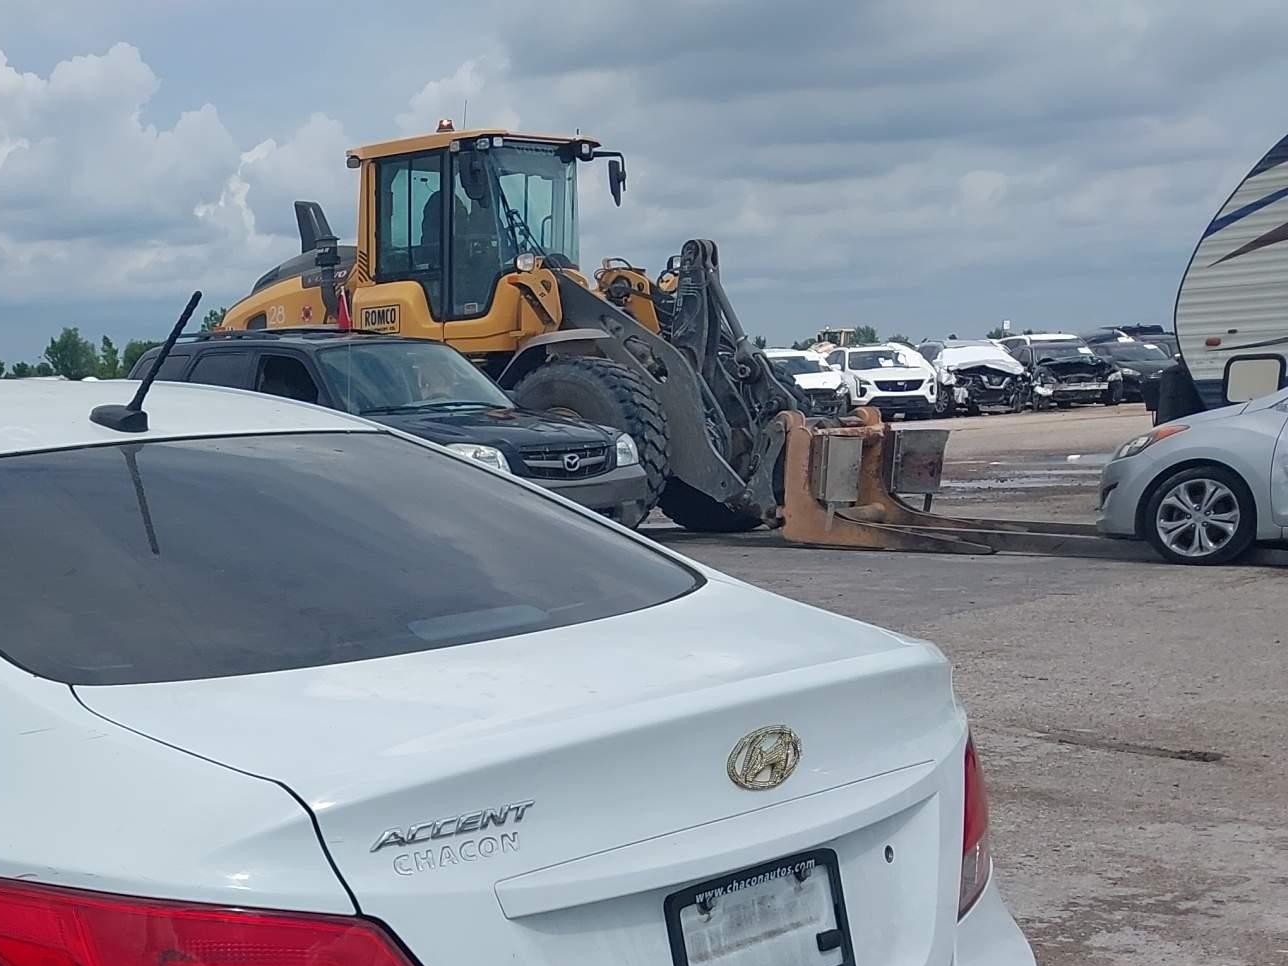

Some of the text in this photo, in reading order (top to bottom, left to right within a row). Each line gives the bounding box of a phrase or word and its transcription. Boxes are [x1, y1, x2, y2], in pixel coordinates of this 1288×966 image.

[364, 308, 396, 328] ROMCO
[370, 799, 536, 853] ACCENT
[393, 831, 521, 876] CHACON
[695, 858, 816, 904] www.chaconautos.com
